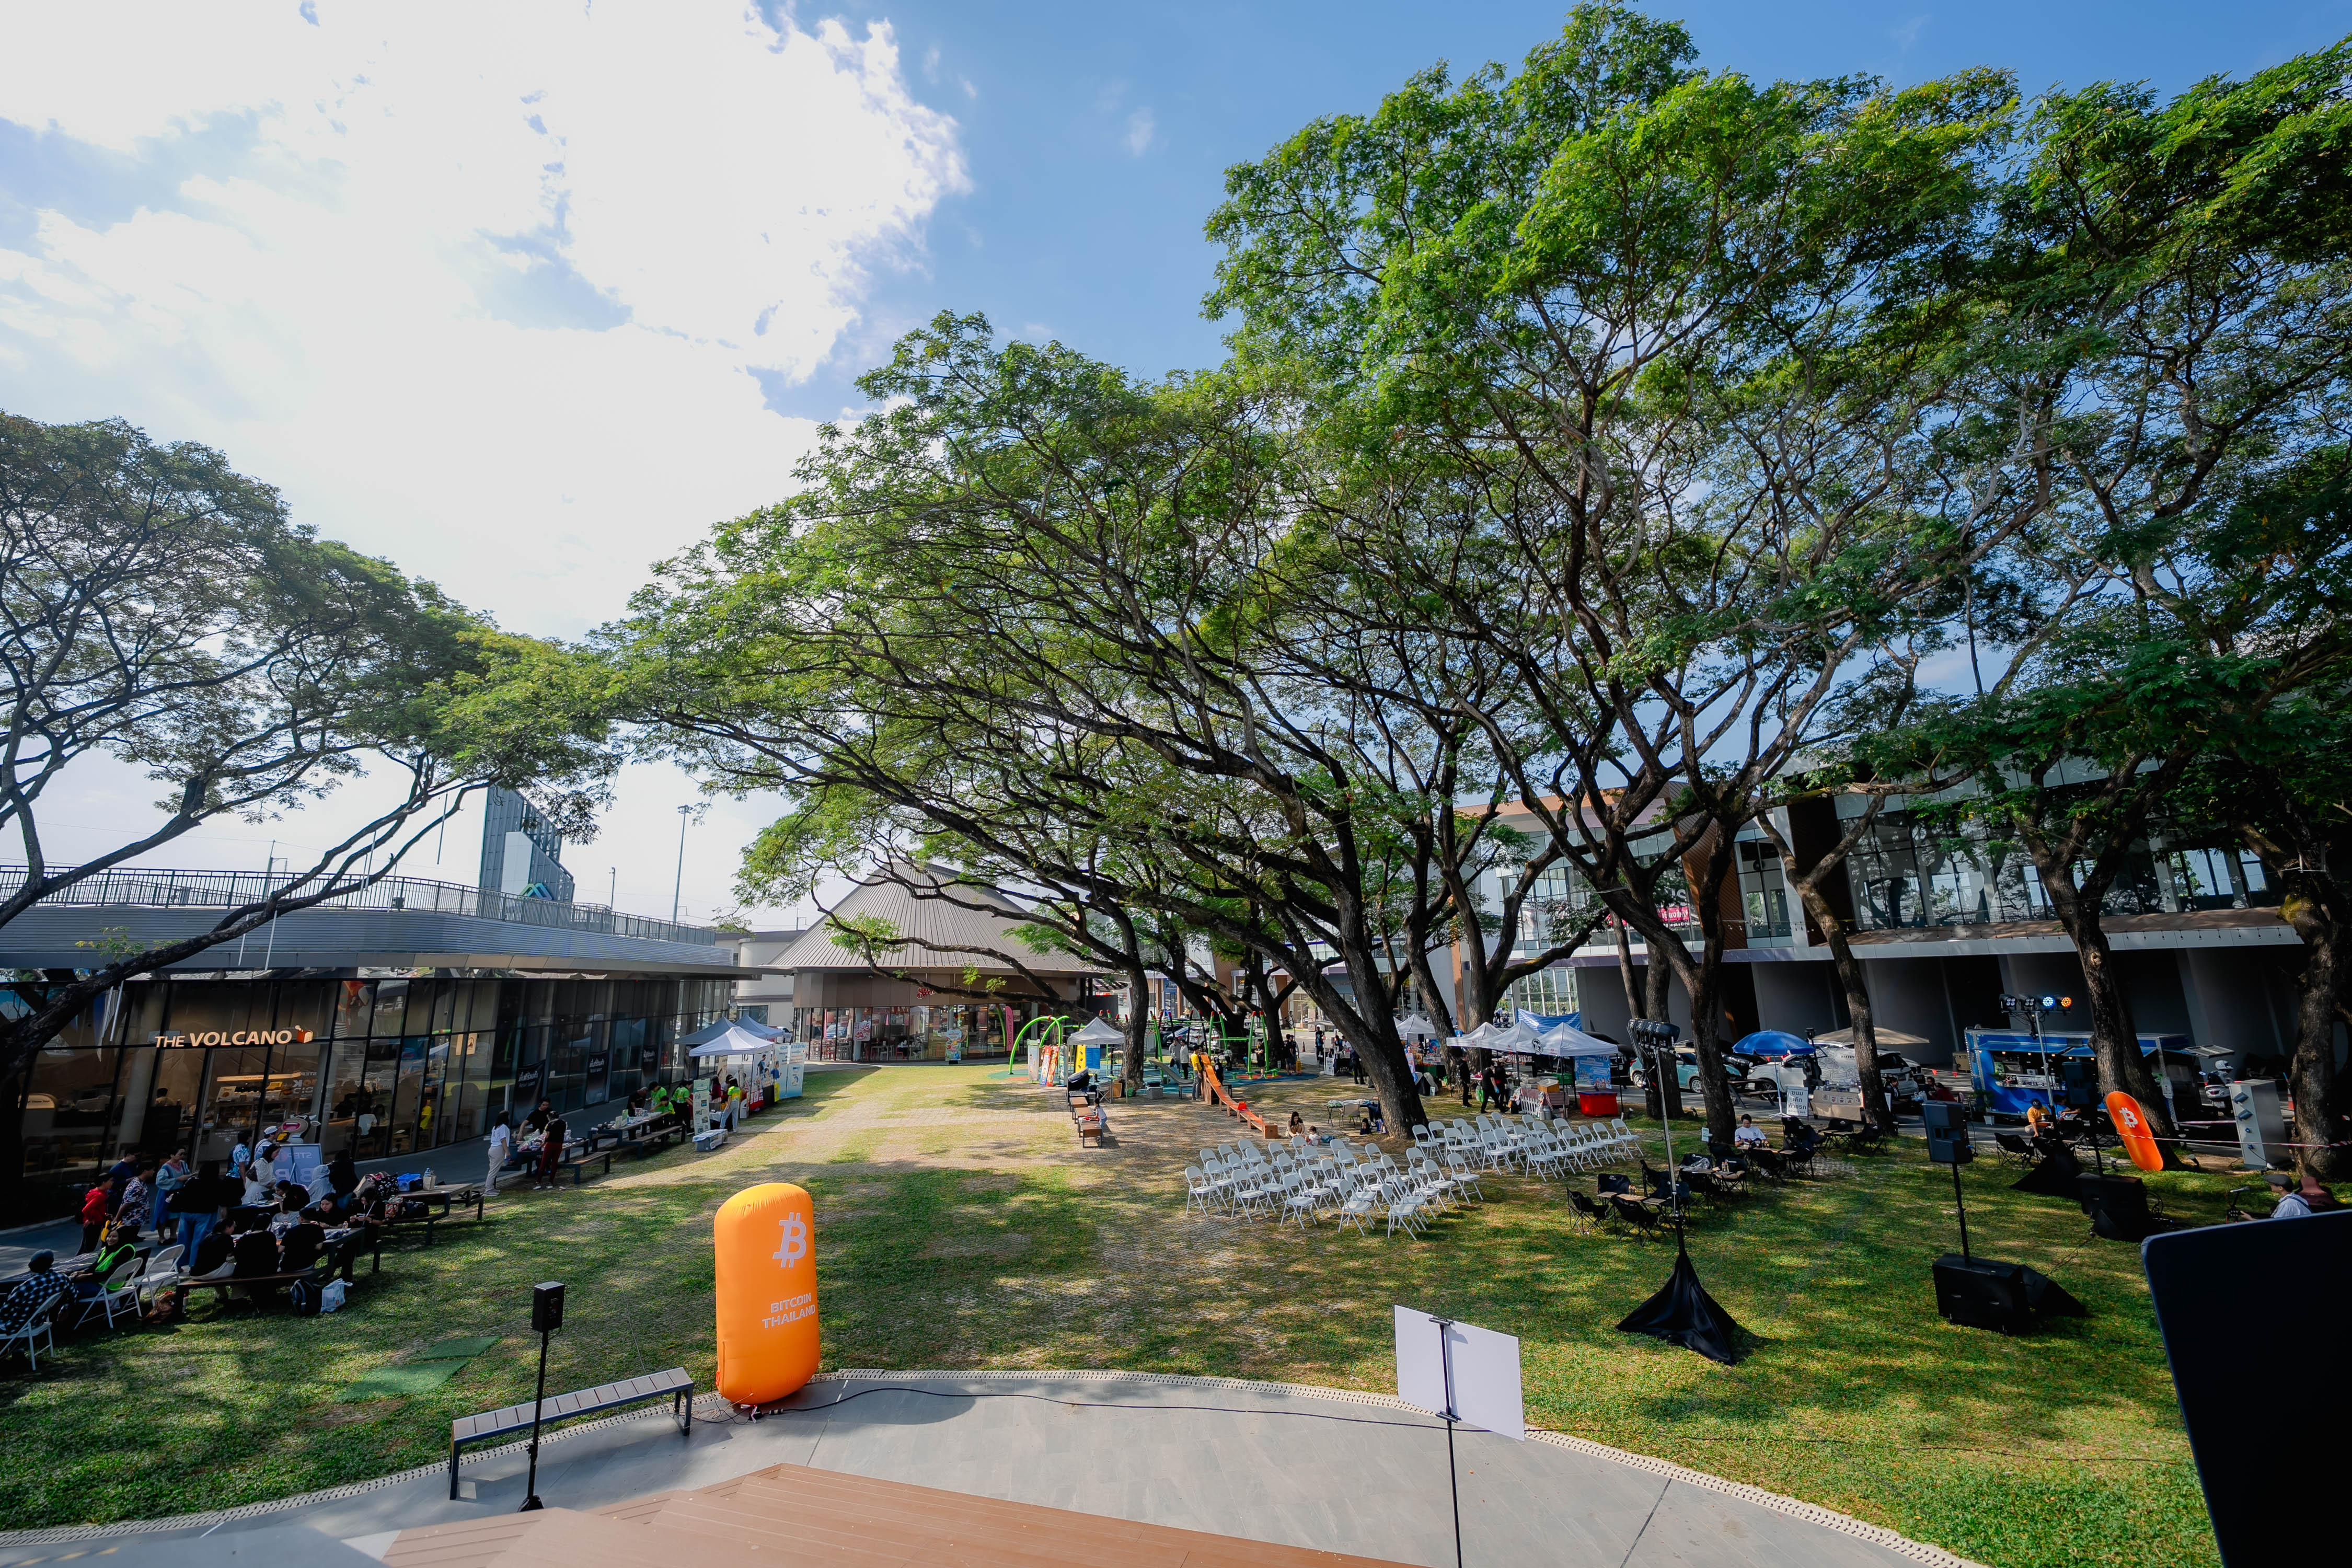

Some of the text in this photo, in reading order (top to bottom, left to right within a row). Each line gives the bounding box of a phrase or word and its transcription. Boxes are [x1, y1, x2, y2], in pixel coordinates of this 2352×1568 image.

[155, 1030, 293, 1048] THE VOLCANO
[770, 1292, 812, 1313] BITCOIN
[762, 1304, 816, 1329] THAILAND
